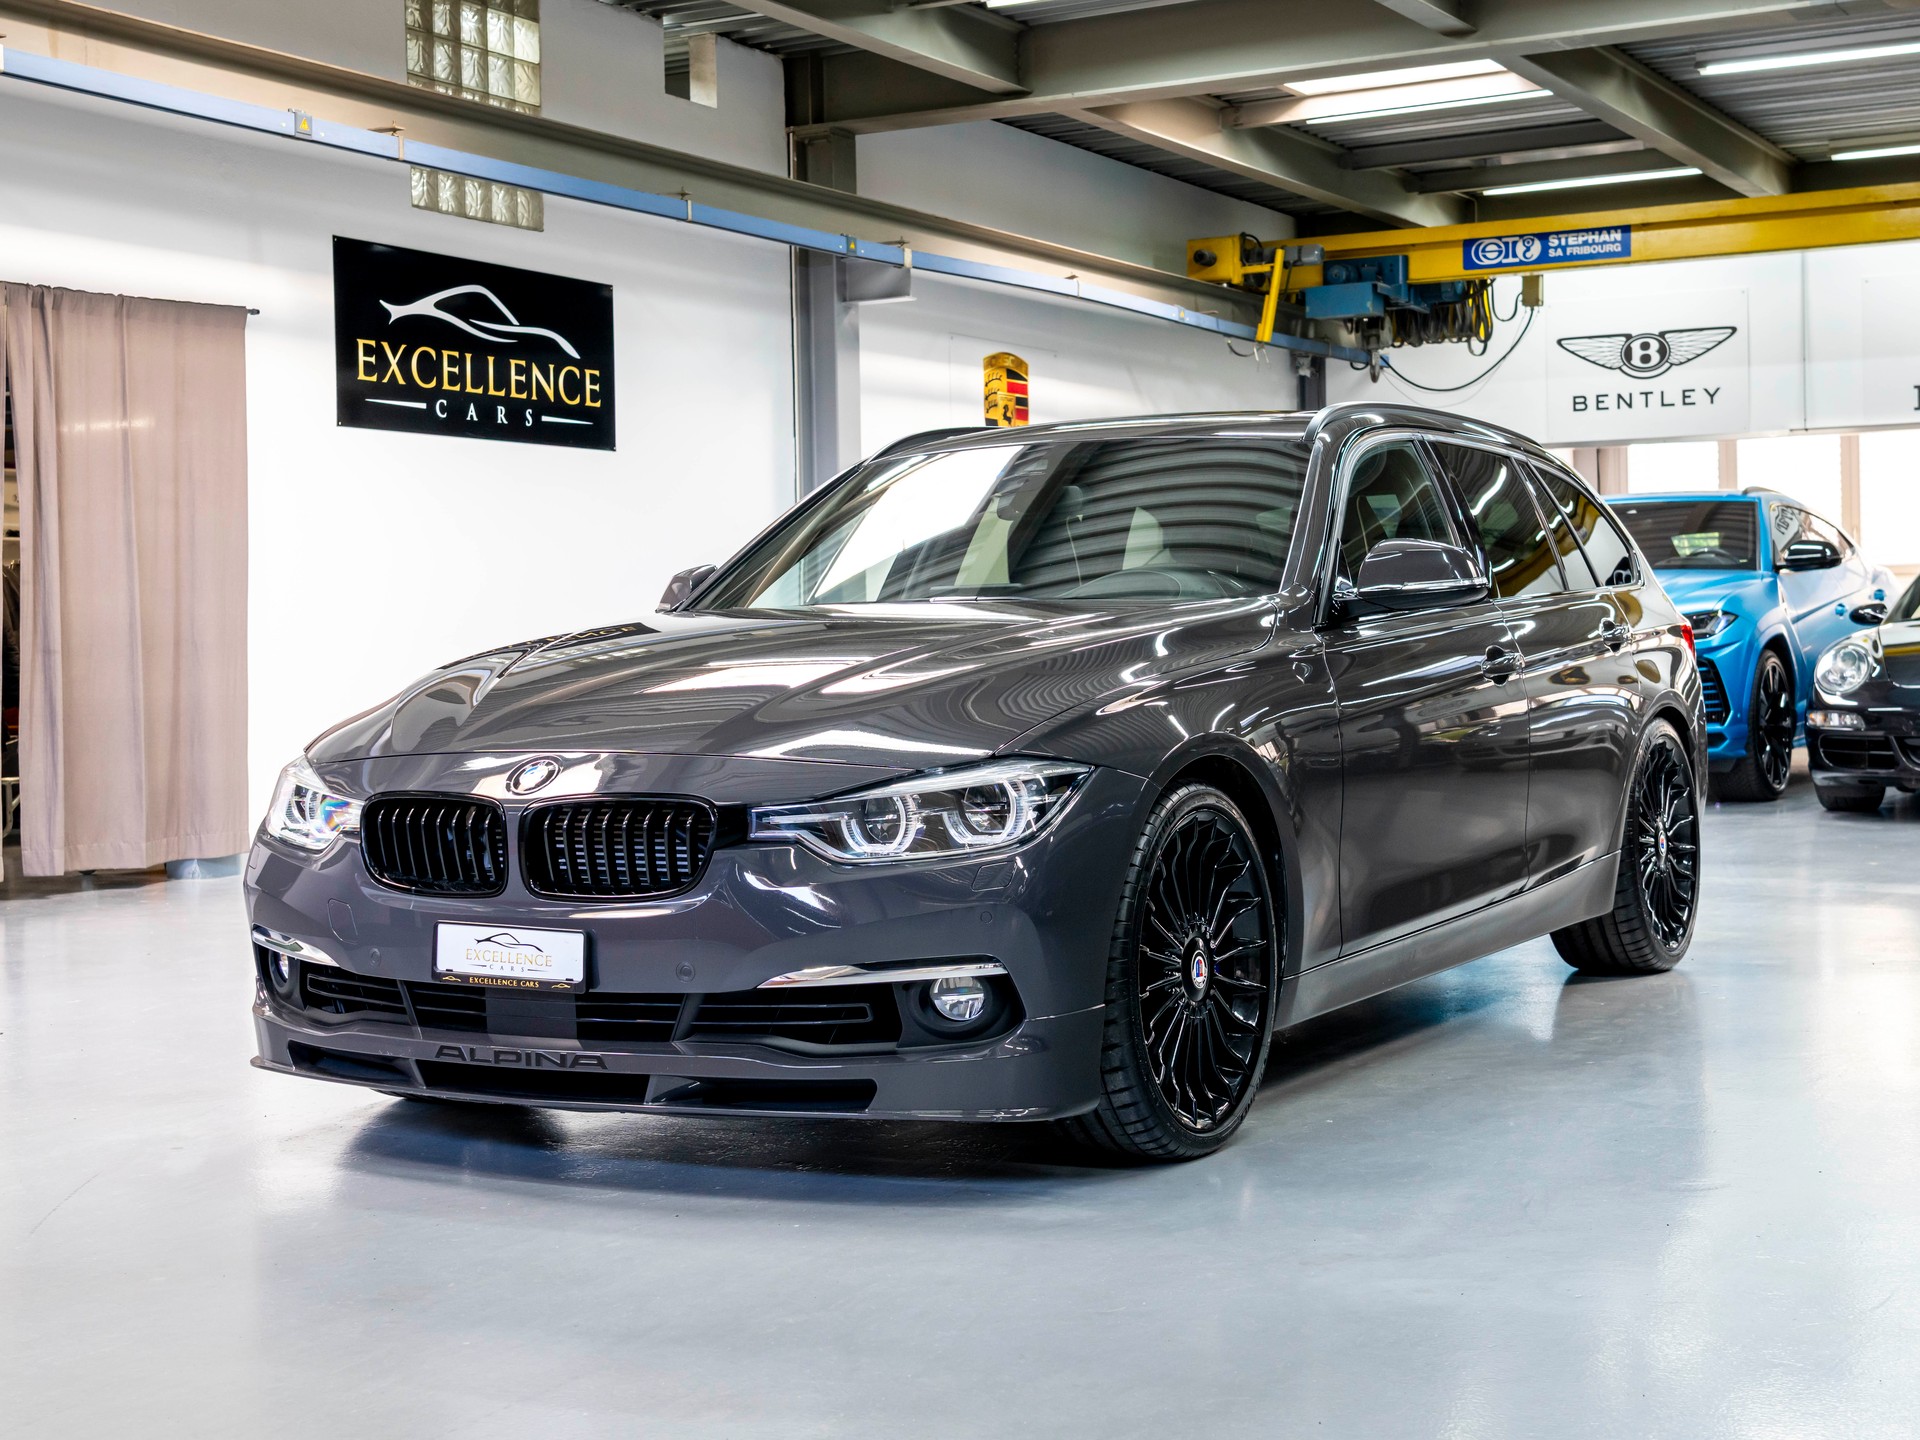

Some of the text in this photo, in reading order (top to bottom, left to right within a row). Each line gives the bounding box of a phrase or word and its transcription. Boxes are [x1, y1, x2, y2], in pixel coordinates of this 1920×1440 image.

[1548, 229, 1622, 248] STEPHAN
[1548, 243, 1622, 258] SA FRIBOURG
[356, 338, 602, 408] EXCELLENCE
[1572, 386, 1721, 412] BENTLEY
[435, 399, 533, 427] CARS
[465, 948, 553, 967] EXCELLENCE
[489, 963, 525, 973] CARS
[469, 976, 540, 988] EXCELLENCE CARS
[434, 1044, 609, 1070] ALPINA
